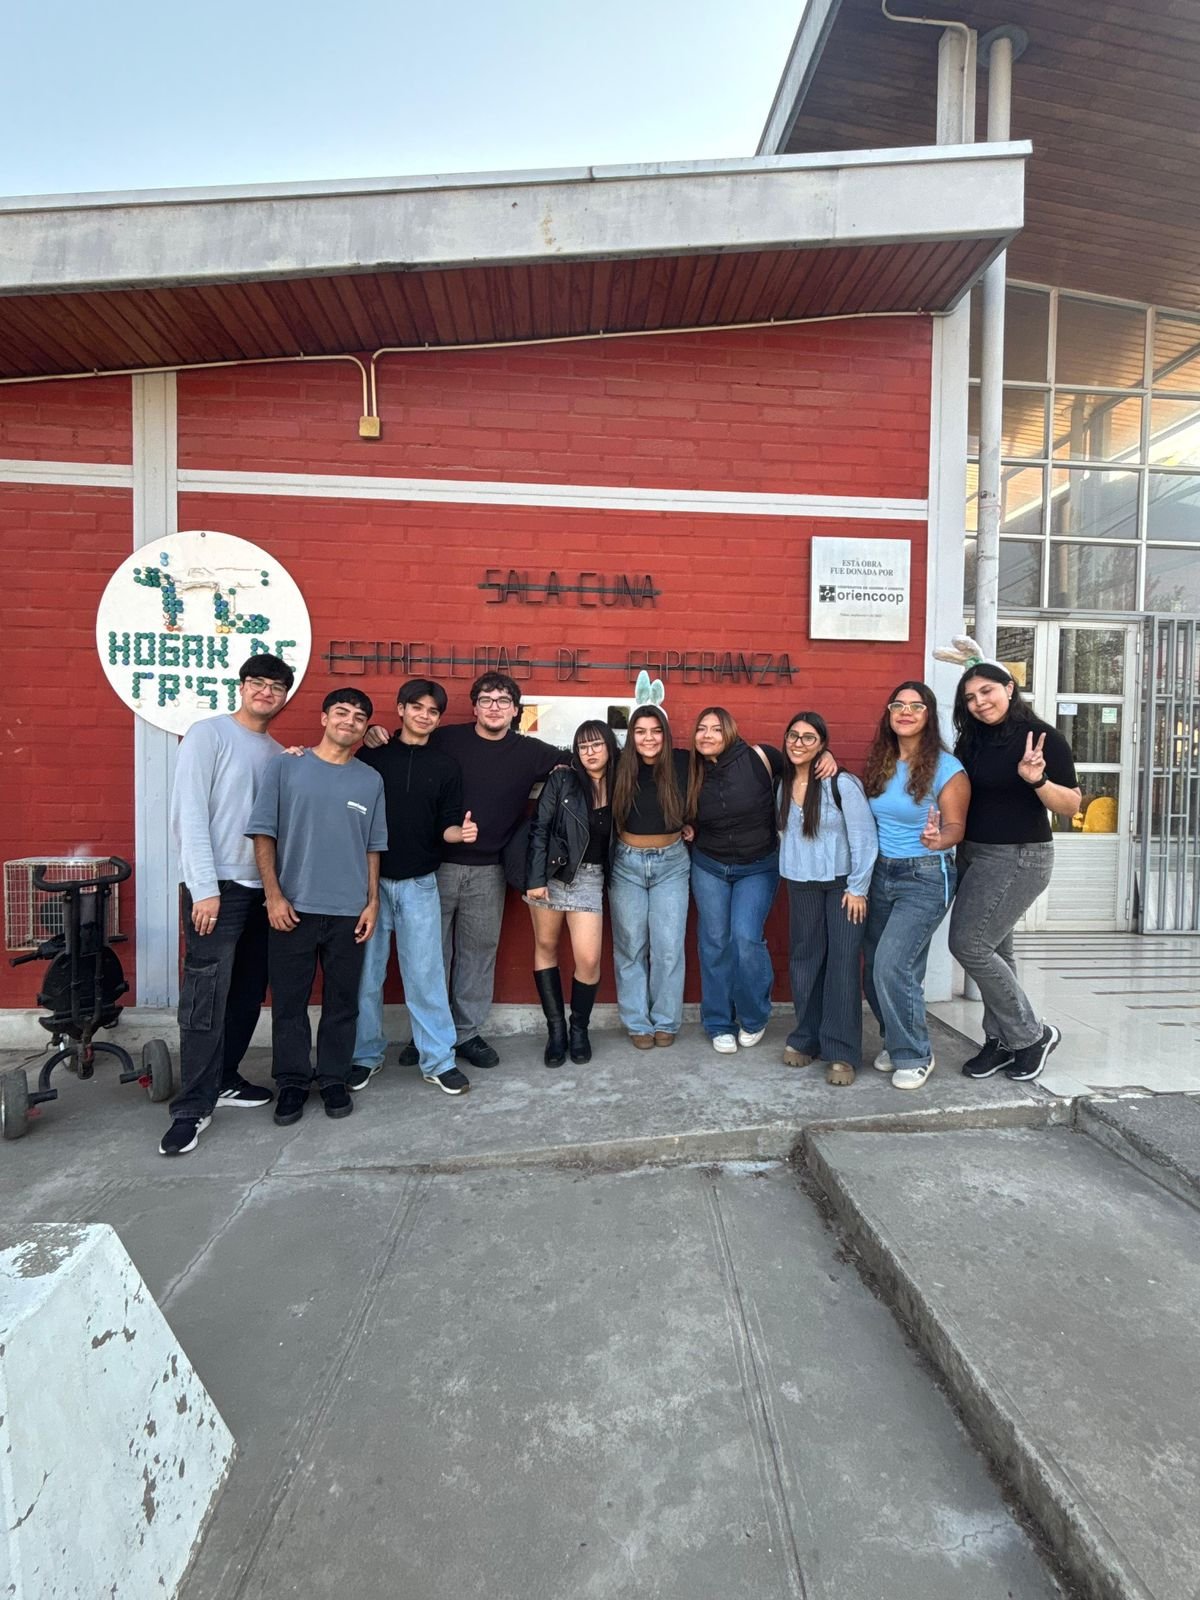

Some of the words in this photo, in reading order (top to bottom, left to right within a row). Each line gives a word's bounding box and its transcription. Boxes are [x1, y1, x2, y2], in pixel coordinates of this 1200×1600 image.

[486, 569, 562, 604] SALA
[830, 567, 846, 575] FUE
[846, 568, 877, 576] DONADA
[837, 590, 904, 605] oriencoop
[108, 631, 229, 669] HOGAR
[328, 640, 532, 680] ESTRELLITAS
[557, 648, 591, 683] DE
[627, 650, 793, 686] ESPERANZA
